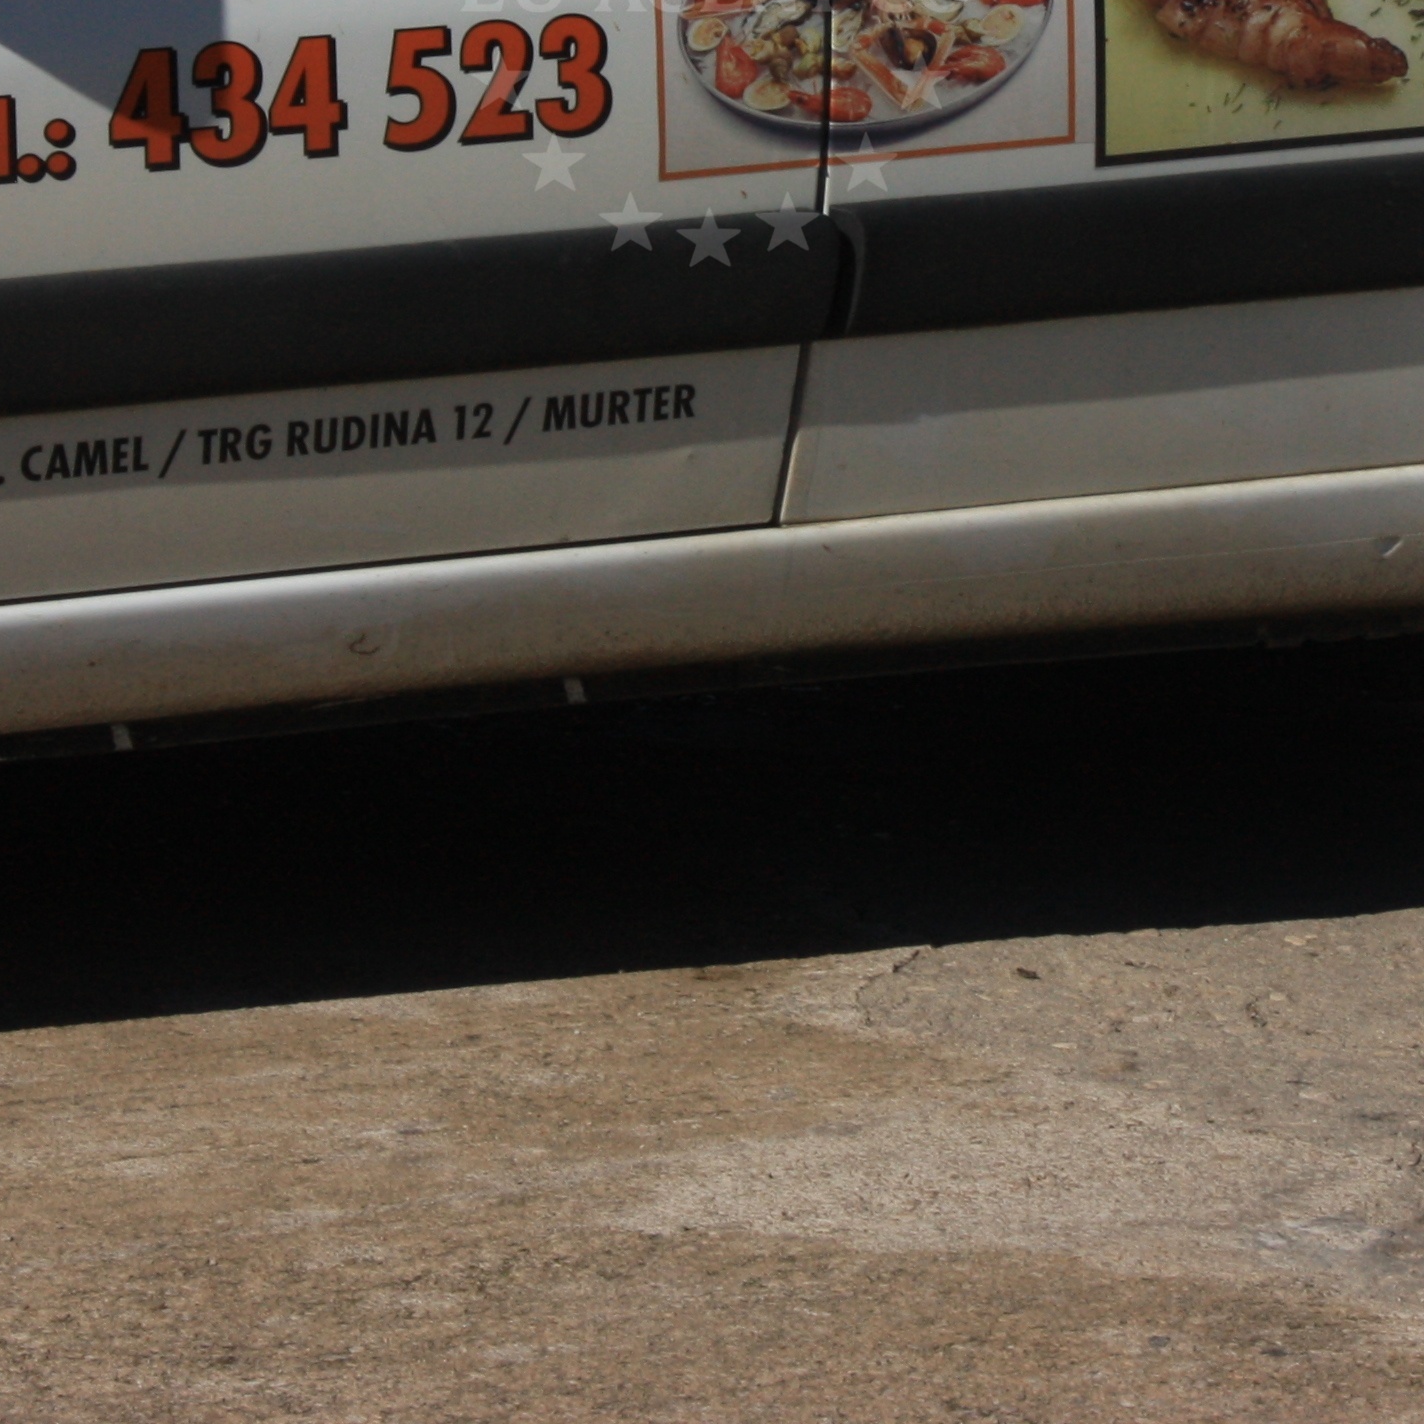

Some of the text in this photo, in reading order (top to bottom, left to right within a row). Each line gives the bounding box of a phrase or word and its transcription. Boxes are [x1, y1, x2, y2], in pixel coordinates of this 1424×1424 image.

[108, 34, 348, 172] 434
[382, 13, 614, 153] 523
[19, 434, 150, 484] CAMEL
[197, 423, 273, 466] TRG
[285, 408, 438, 457] RUDINA
[453, 402, 494, 442] 12
[541, 383, 697, 433] MURTER
